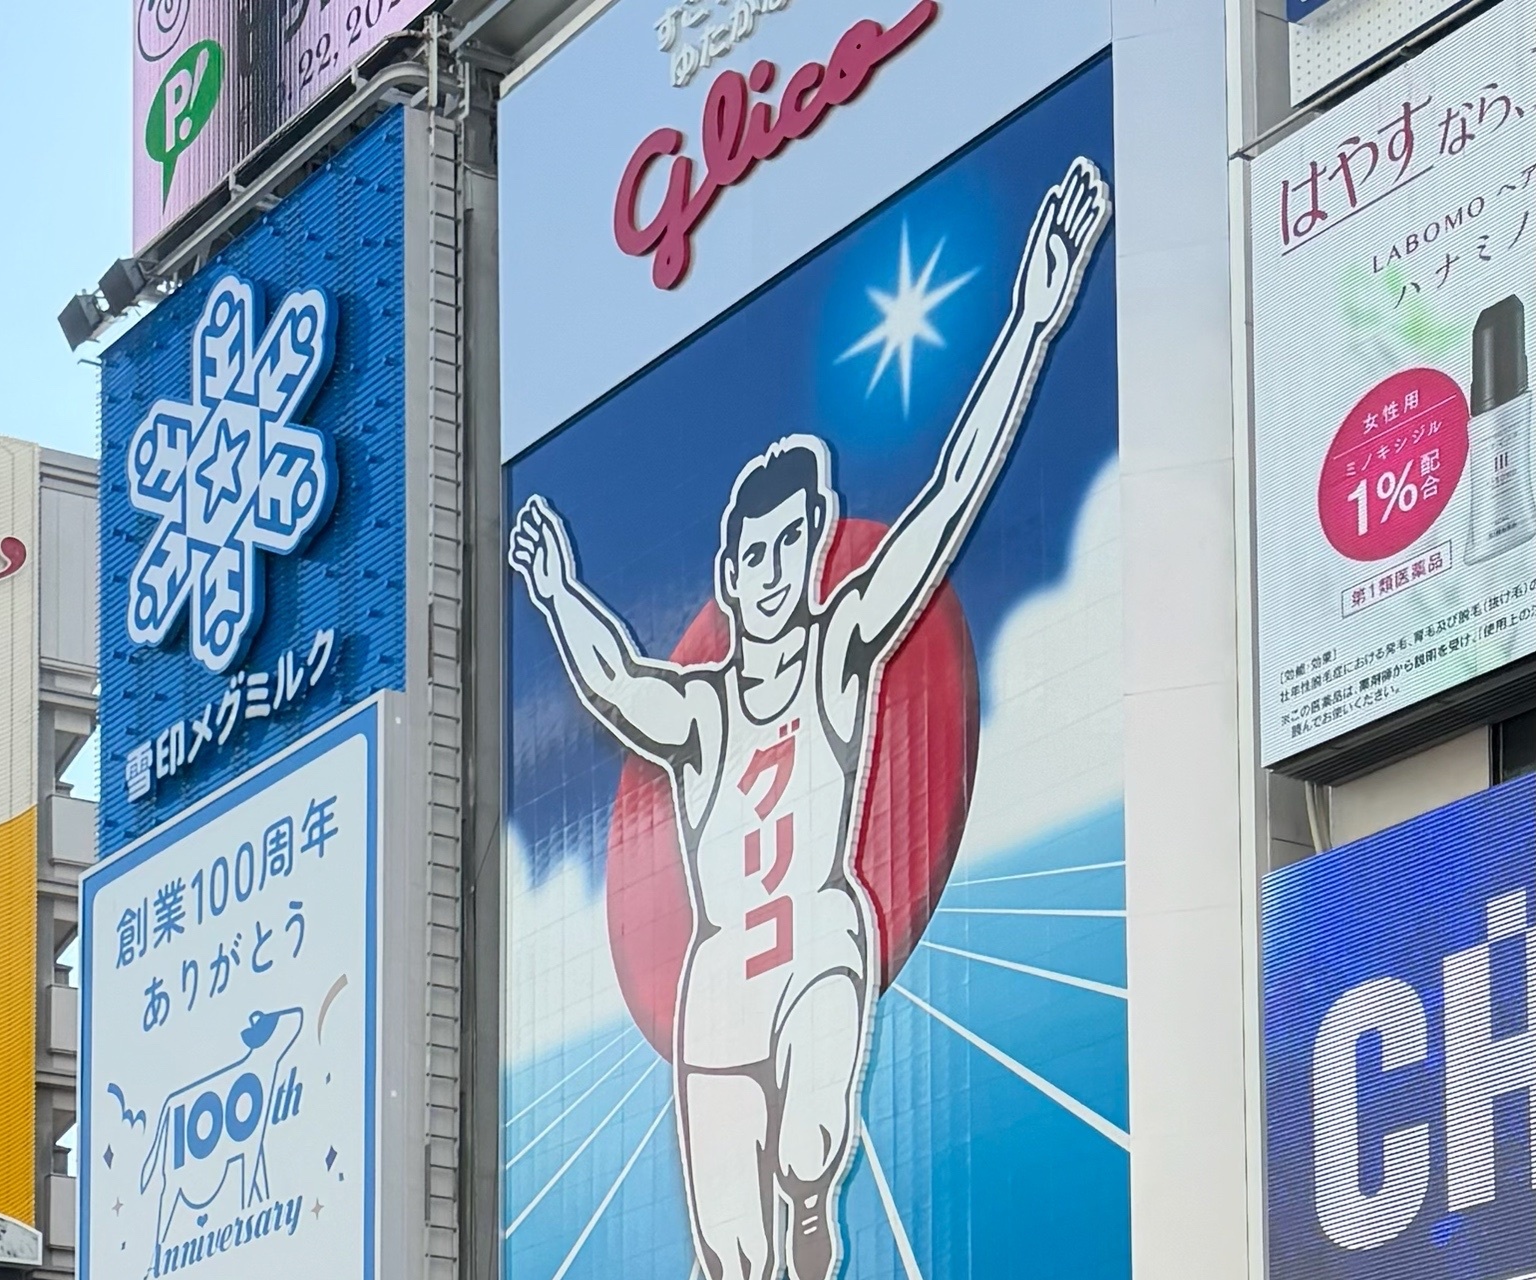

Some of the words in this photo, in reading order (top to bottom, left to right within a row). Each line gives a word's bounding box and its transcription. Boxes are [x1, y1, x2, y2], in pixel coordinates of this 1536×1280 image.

[346, 0, 400, 47] 20
[613, 0, 939, 291] Glico
[1372, 196, 1485, 274] LABOMO
[1344, 418, 1443, 478] ミノキシジル
[1362, 389, 1420, 434] 女性用
[1346, 460, 1418, 537] 1%
[1419, 447, 1442, 500] 配合
[1350, 551, 1444, 607] 第1類医薬品
[124, 627, 337, 805] 雪印メグミルク
[115, 794, 340, 970] 創業100周年
[736, 717, 801, 981] グリコ
[142, 900, 306, 1033] ありがとう
[173, 1065, 304, 1171] 100th
